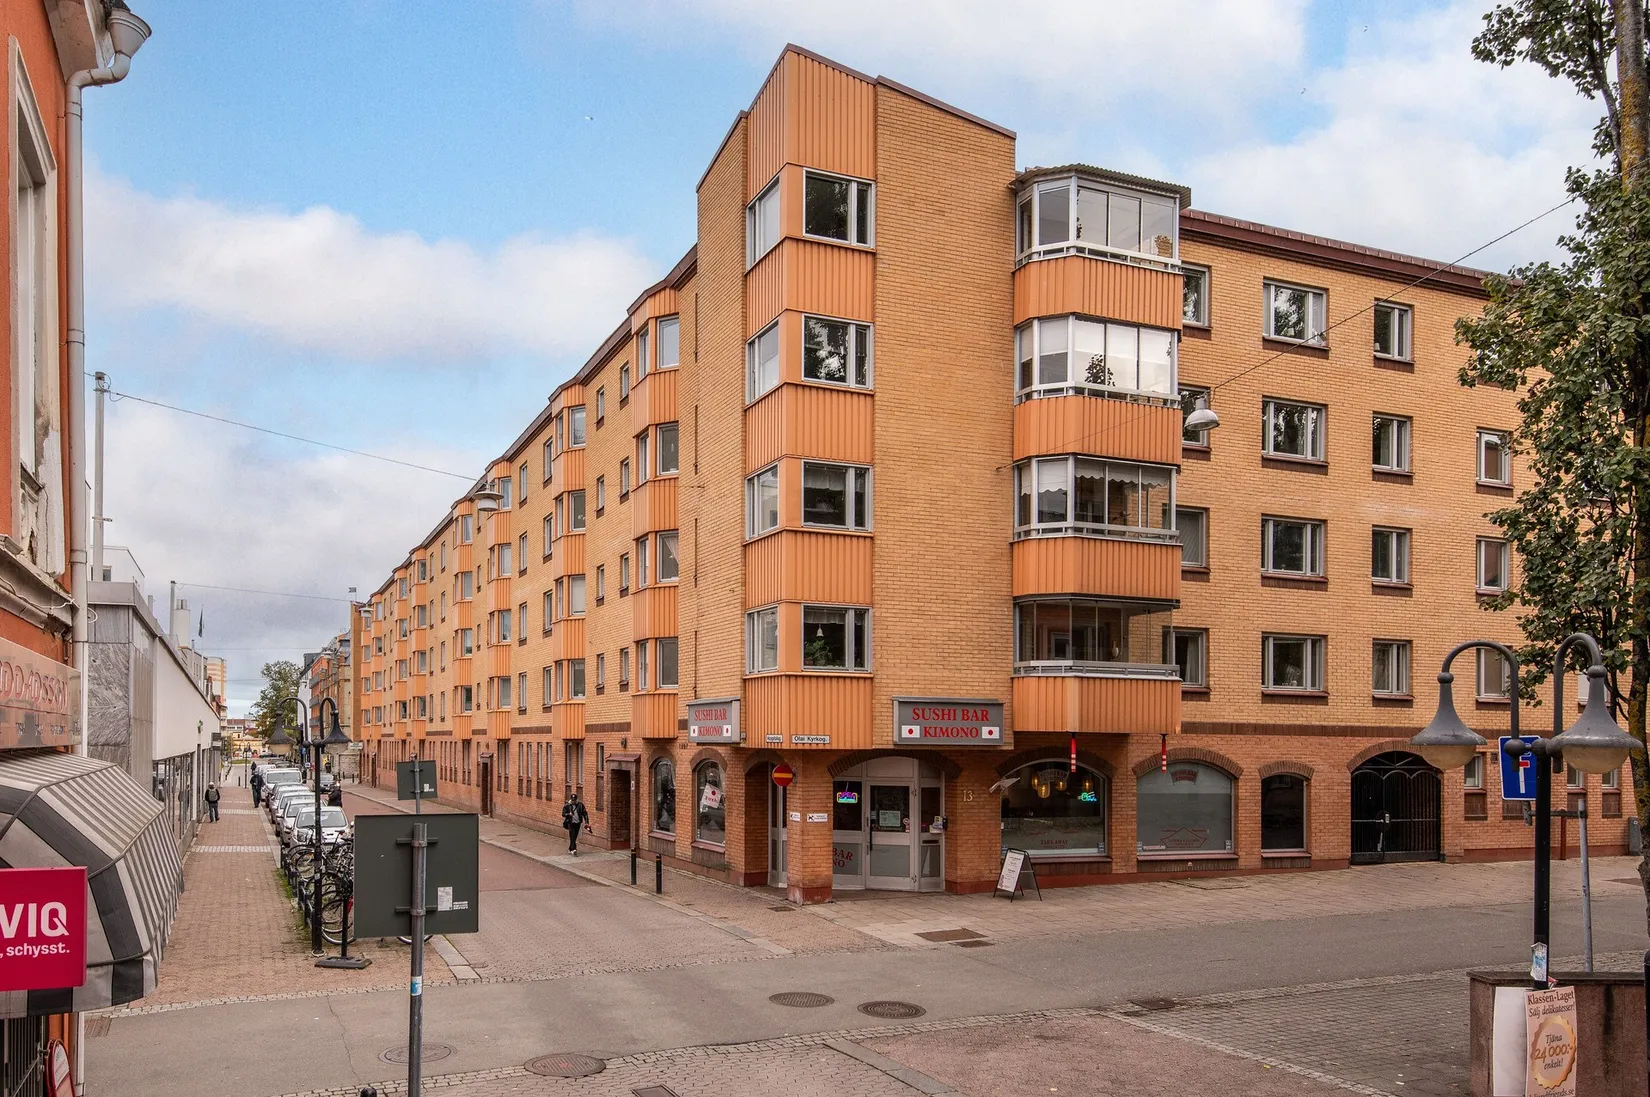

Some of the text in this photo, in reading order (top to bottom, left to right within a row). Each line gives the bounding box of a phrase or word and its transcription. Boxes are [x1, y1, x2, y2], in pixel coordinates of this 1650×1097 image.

[694, 708, 728, 721] SUSHI BAR
[912, 707, 990, 722] SUSHI BAR
[698, 726, 722, 737] KIMONO
[923, 726, 979, 738] KIMONO
[963, 790, 973, 801] 13
[0, 902, 70, 938] VIQ
[6, 942, 70, 958] schysst.
[1529, 1002, 1576, 1019] Sälj delikatesser!
[1545, 1034, 1563, 1046] Tjäna
[1543, 1058, 1564, 1070] enkelt!
